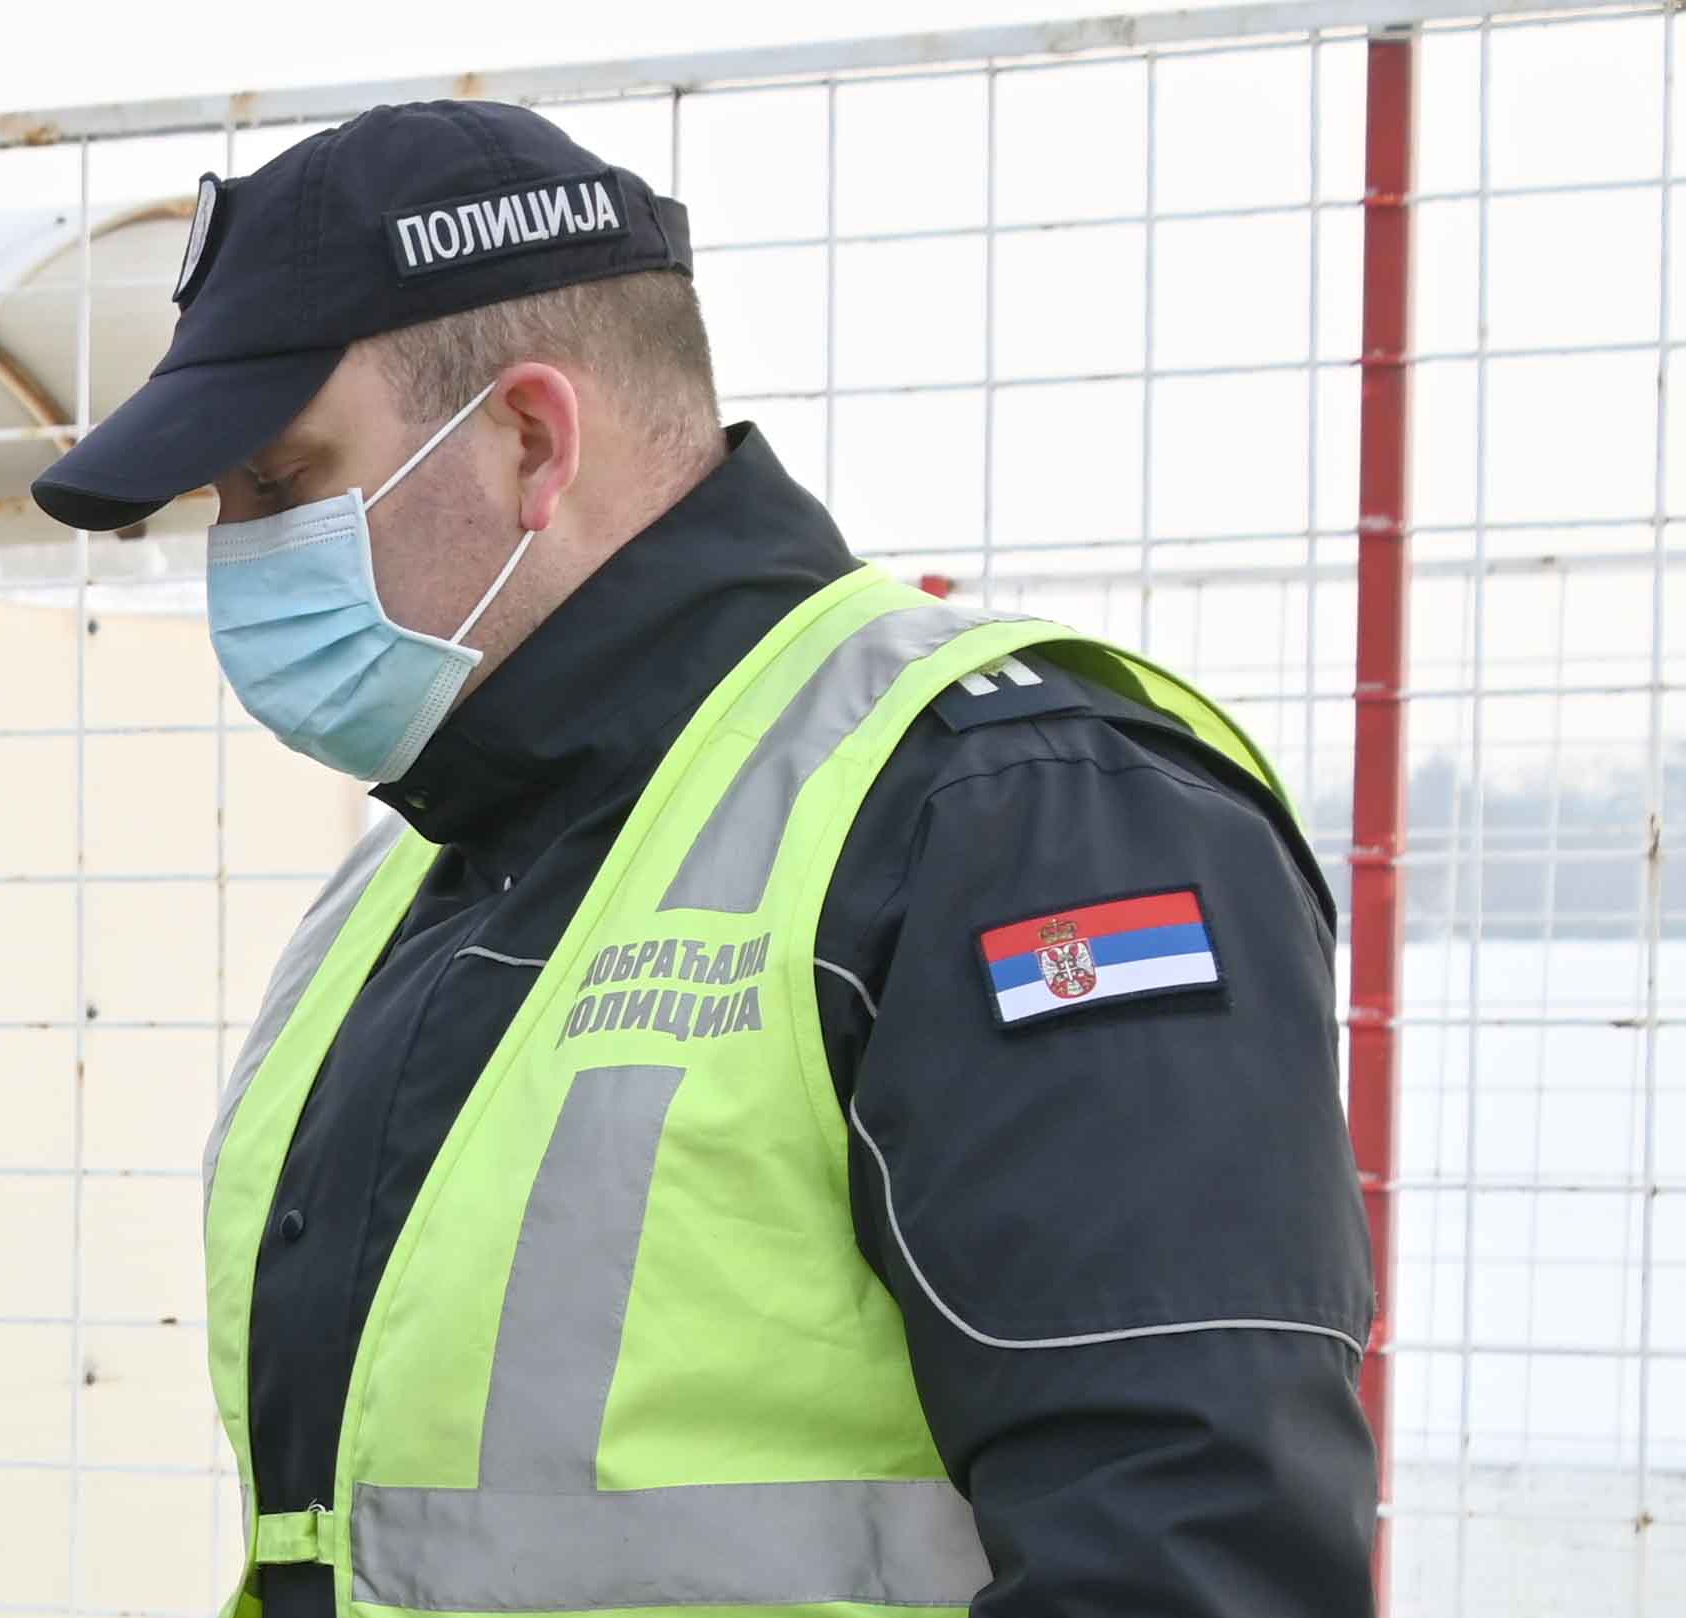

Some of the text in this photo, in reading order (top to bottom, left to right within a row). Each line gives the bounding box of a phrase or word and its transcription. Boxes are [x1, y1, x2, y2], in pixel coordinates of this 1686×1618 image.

[396, 181, 620, 267] ПОЛИЦИЈА
[578, 931, 771, 991] ОБРАЋАЈНА
[556, 986, 763, 1050] ОЛИЦИЈА
